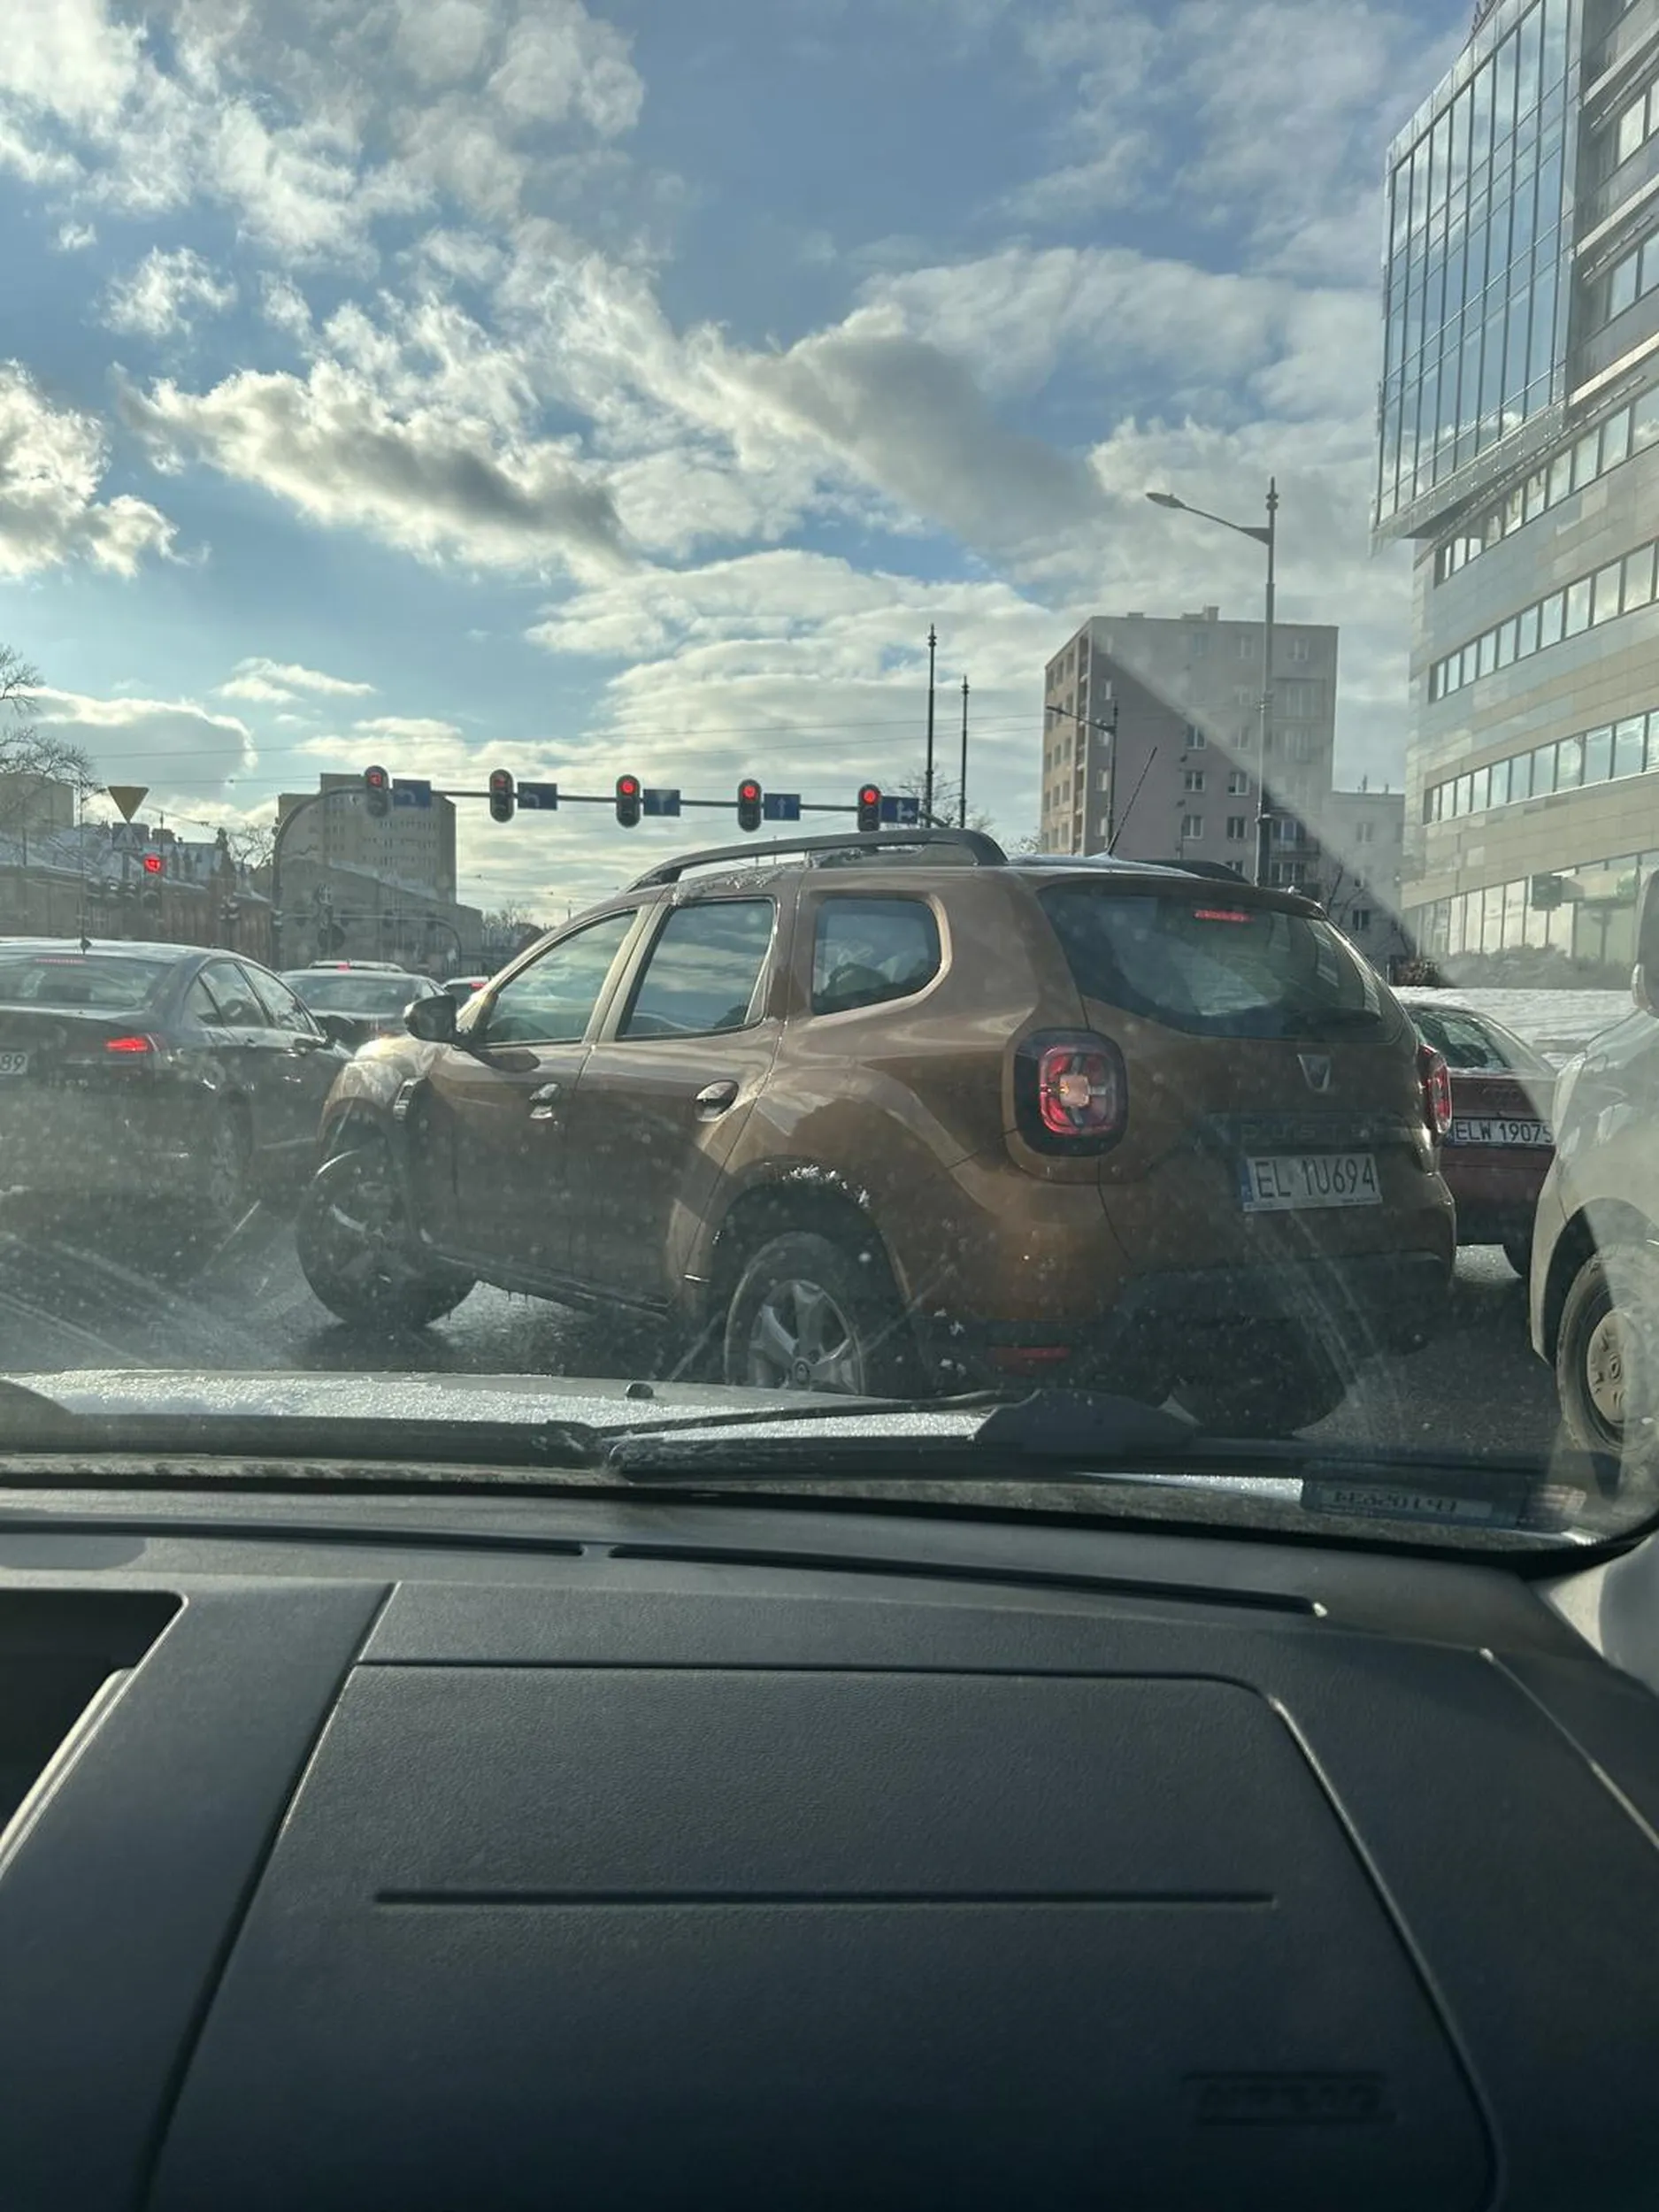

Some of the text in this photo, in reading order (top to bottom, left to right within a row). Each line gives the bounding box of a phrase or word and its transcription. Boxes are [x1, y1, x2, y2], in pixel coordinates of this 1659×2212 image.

[1455, 1121, 1554, 1143] ELW 19075
[1255, 1159, 1291, 1198] EL
